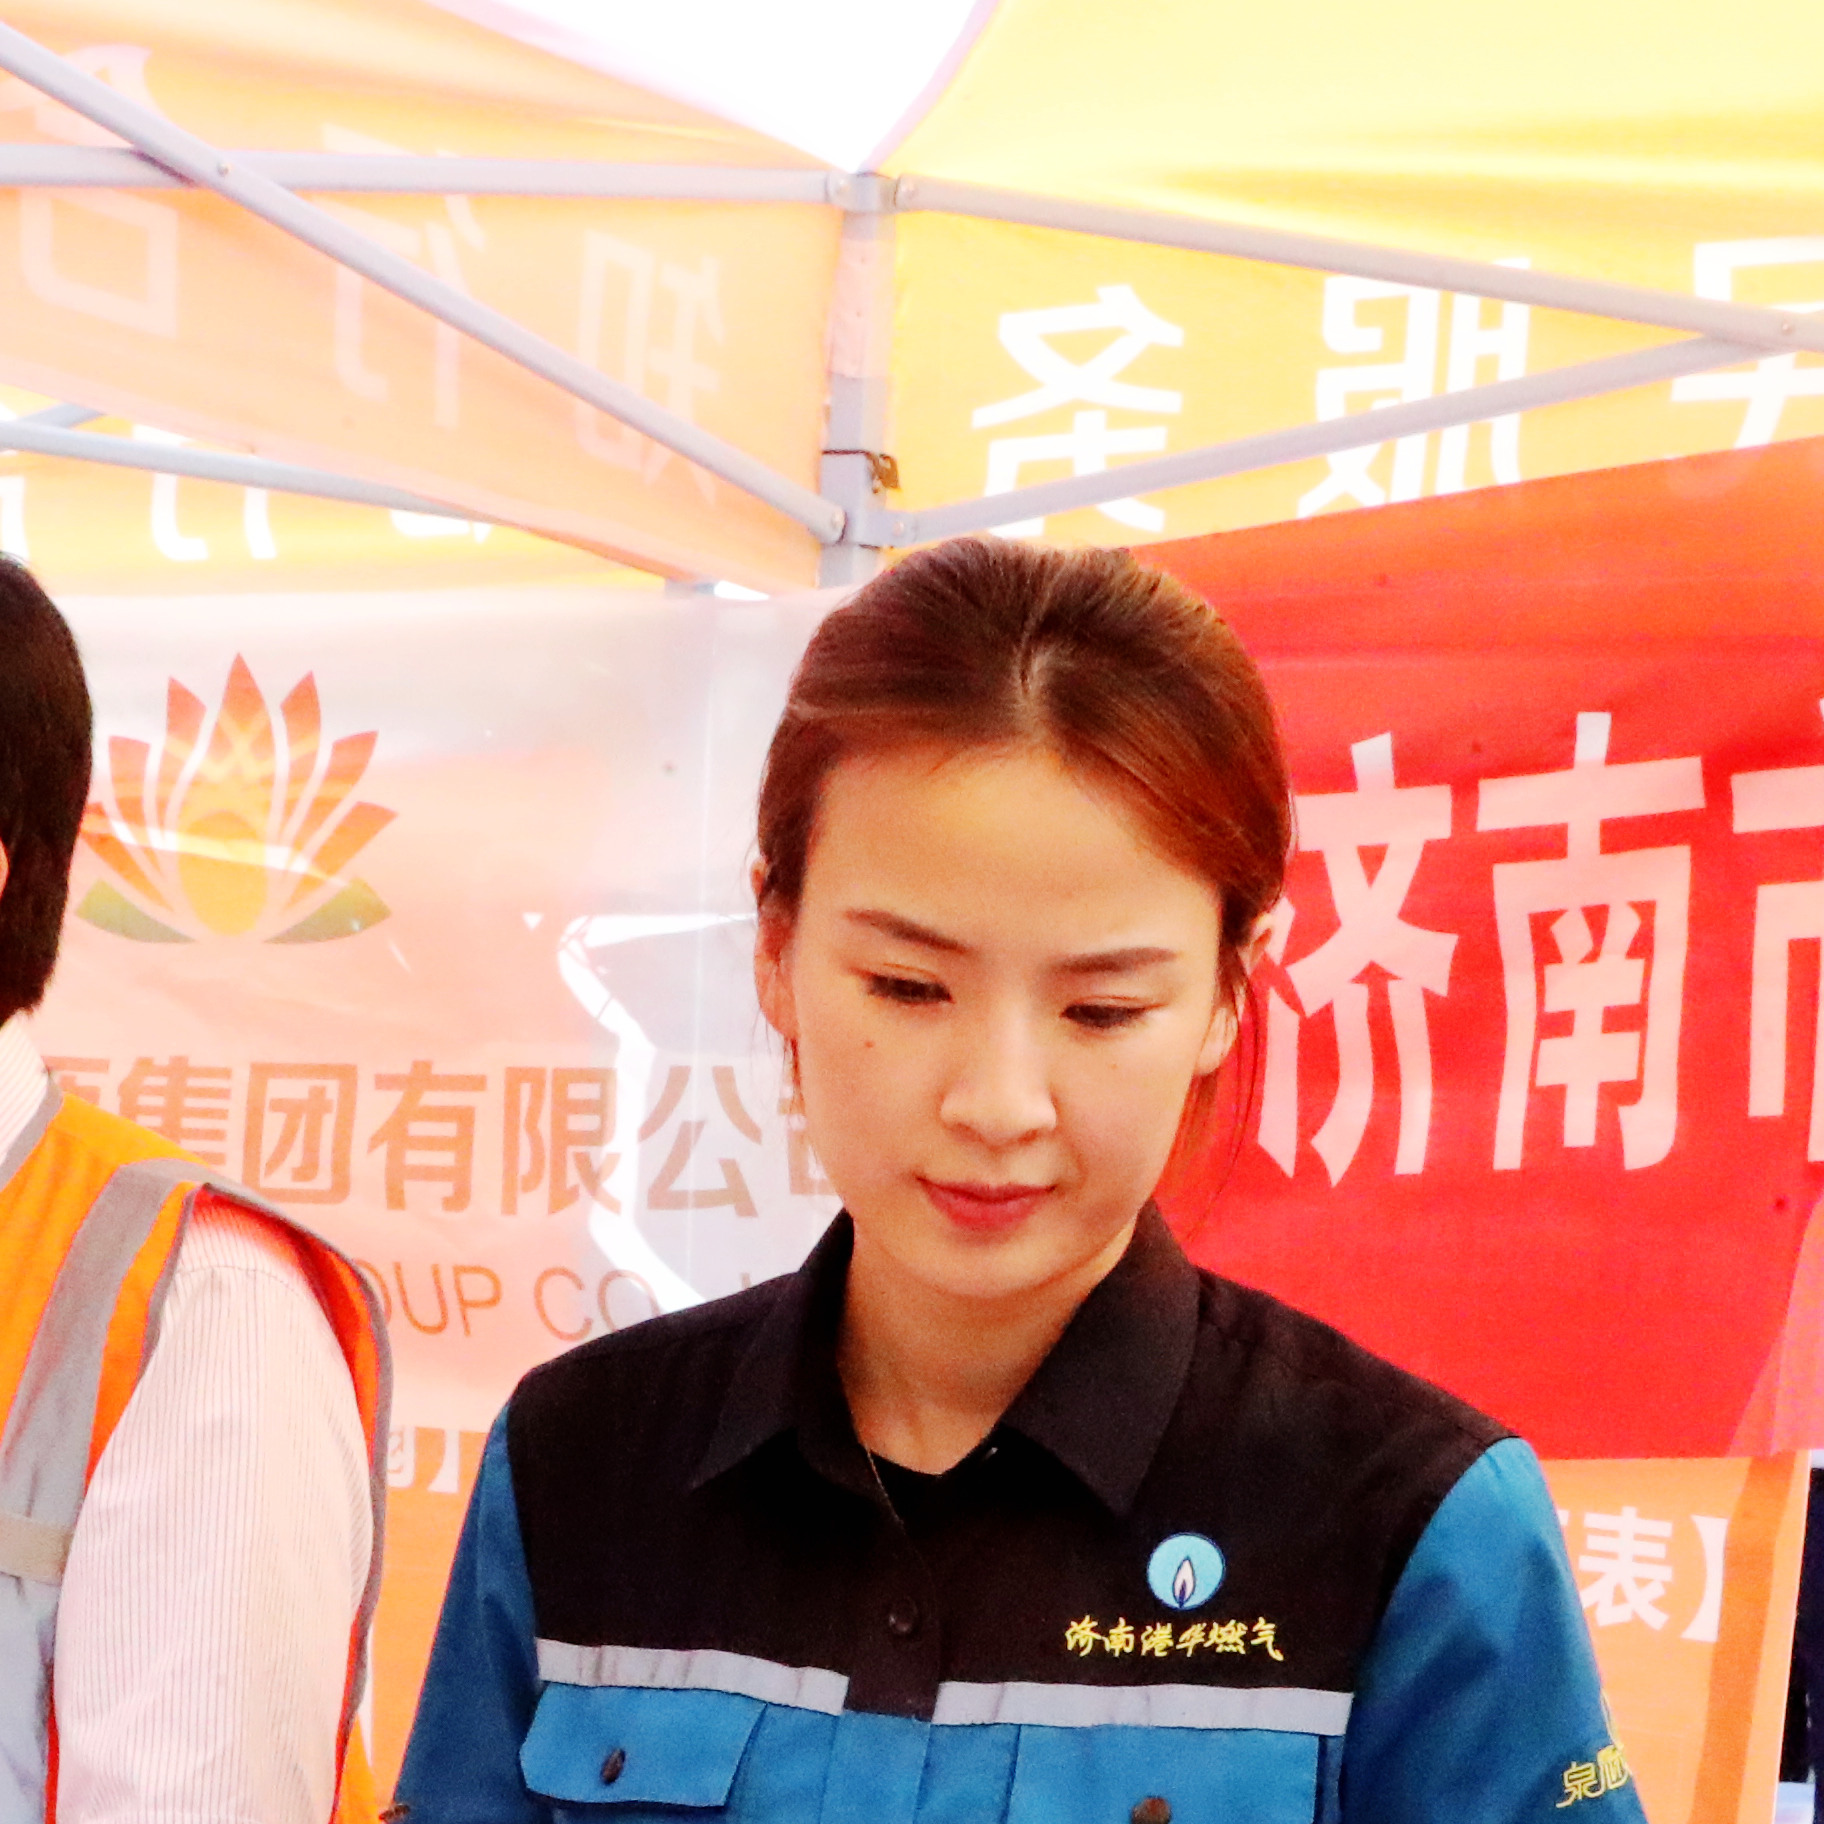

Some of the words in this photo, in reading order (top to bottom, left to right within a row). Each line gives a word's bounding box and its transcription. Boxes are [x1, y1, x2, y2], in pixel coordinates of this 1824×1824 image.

[1064, 1613, 1285, 1661] 济南港华燃气
